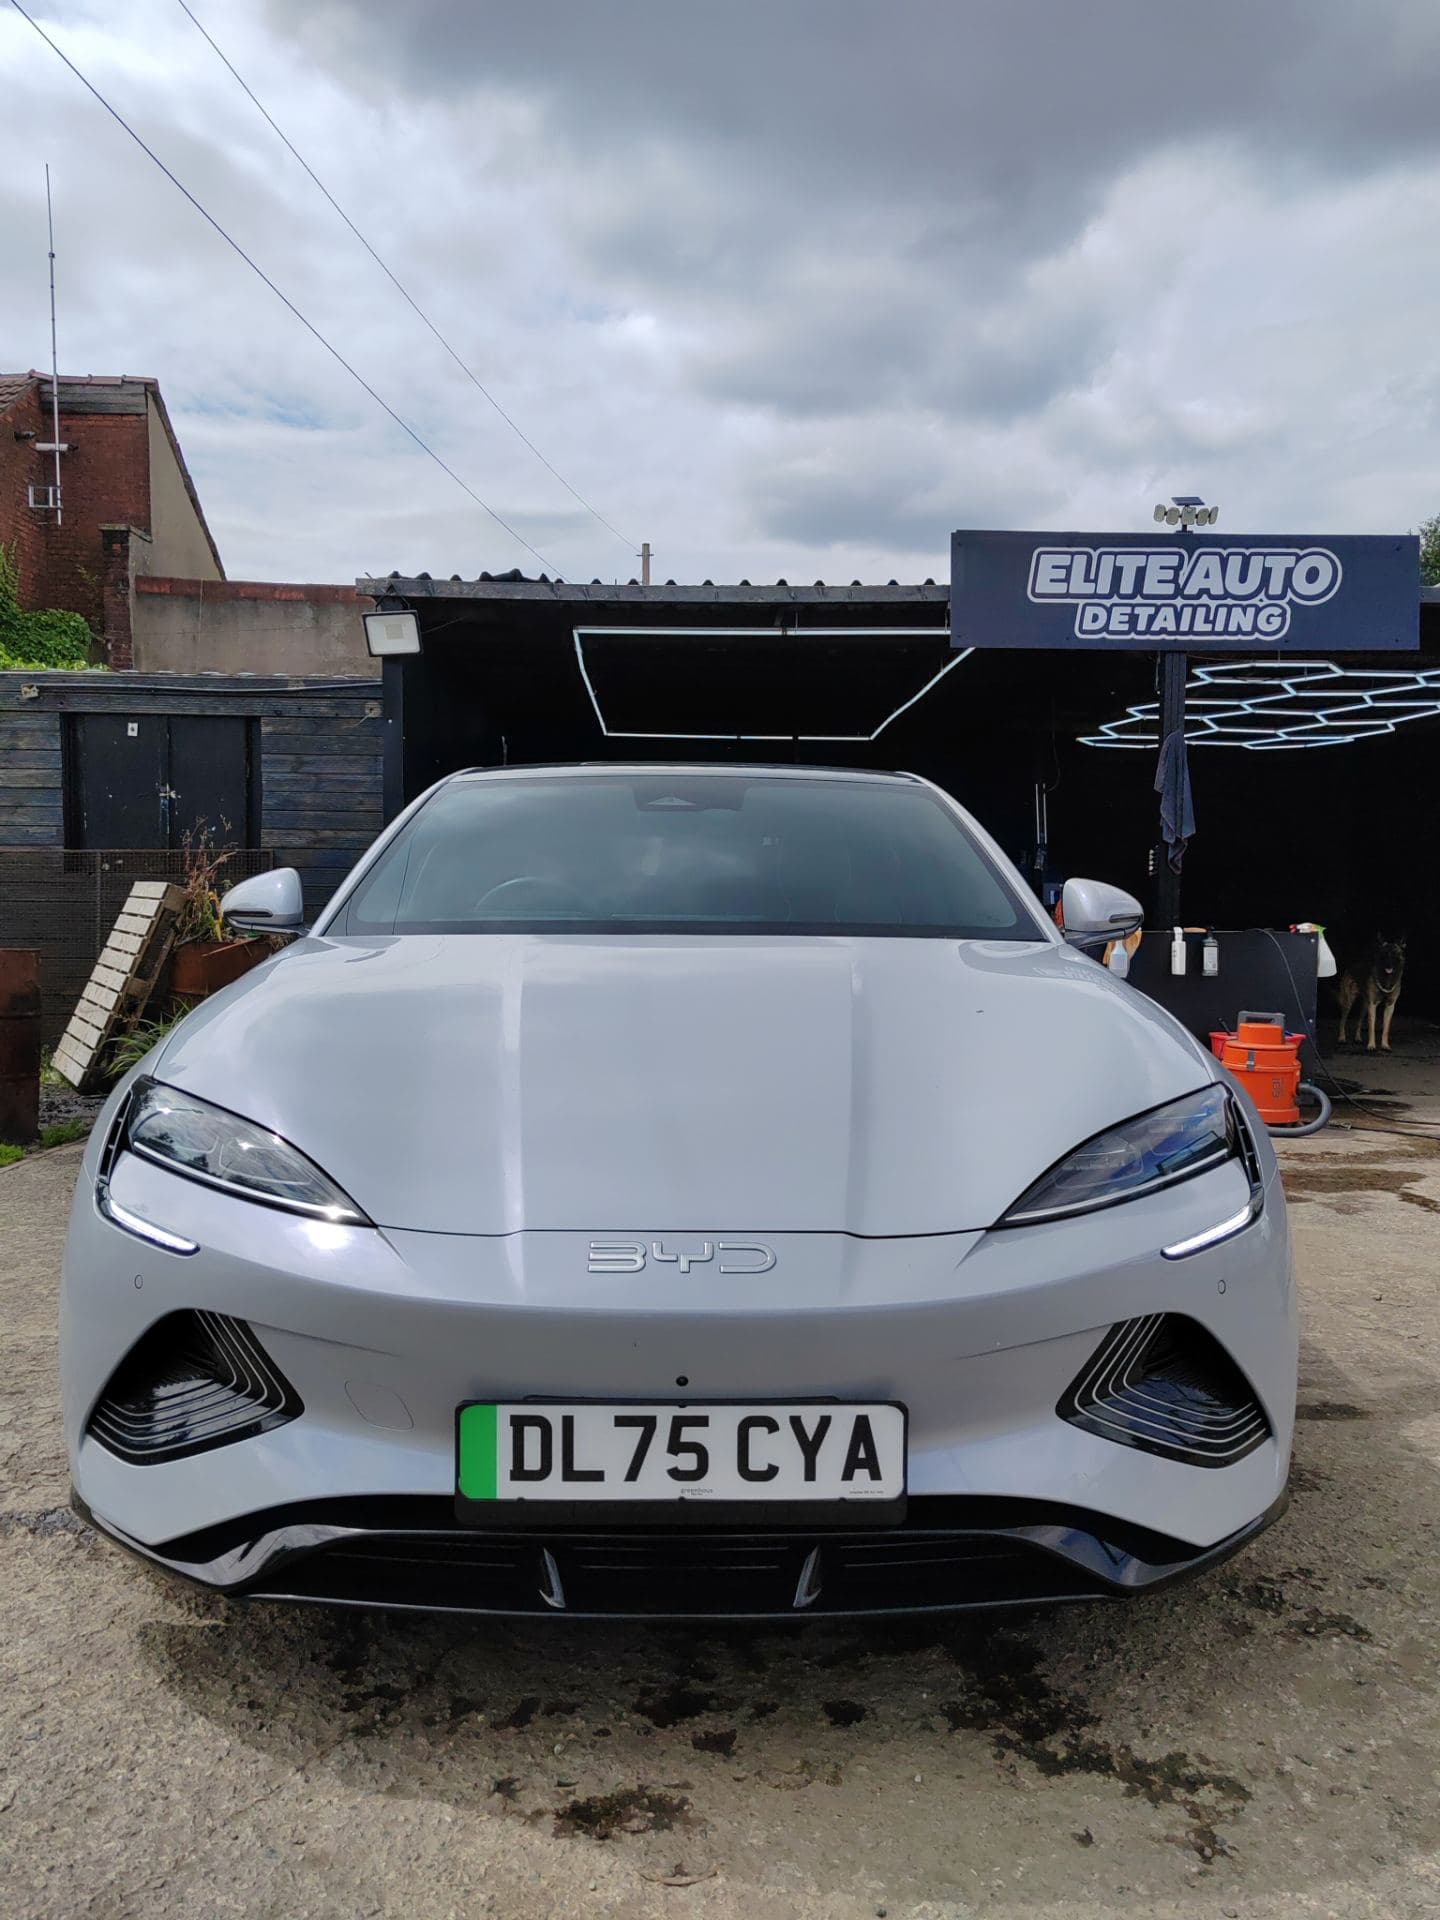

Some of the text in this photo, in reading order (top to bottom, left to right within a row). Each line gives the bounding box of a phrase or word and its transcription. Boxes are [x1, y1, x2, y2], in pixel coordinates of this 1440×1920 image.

[1033, 552, 1334, 597] ELITE AUTO
[1081, 604, 1287, 634] DETAILING
[587, 1240, 777, 1274] BYD
[509, 1414, 884, 1482] DL75 CYA
